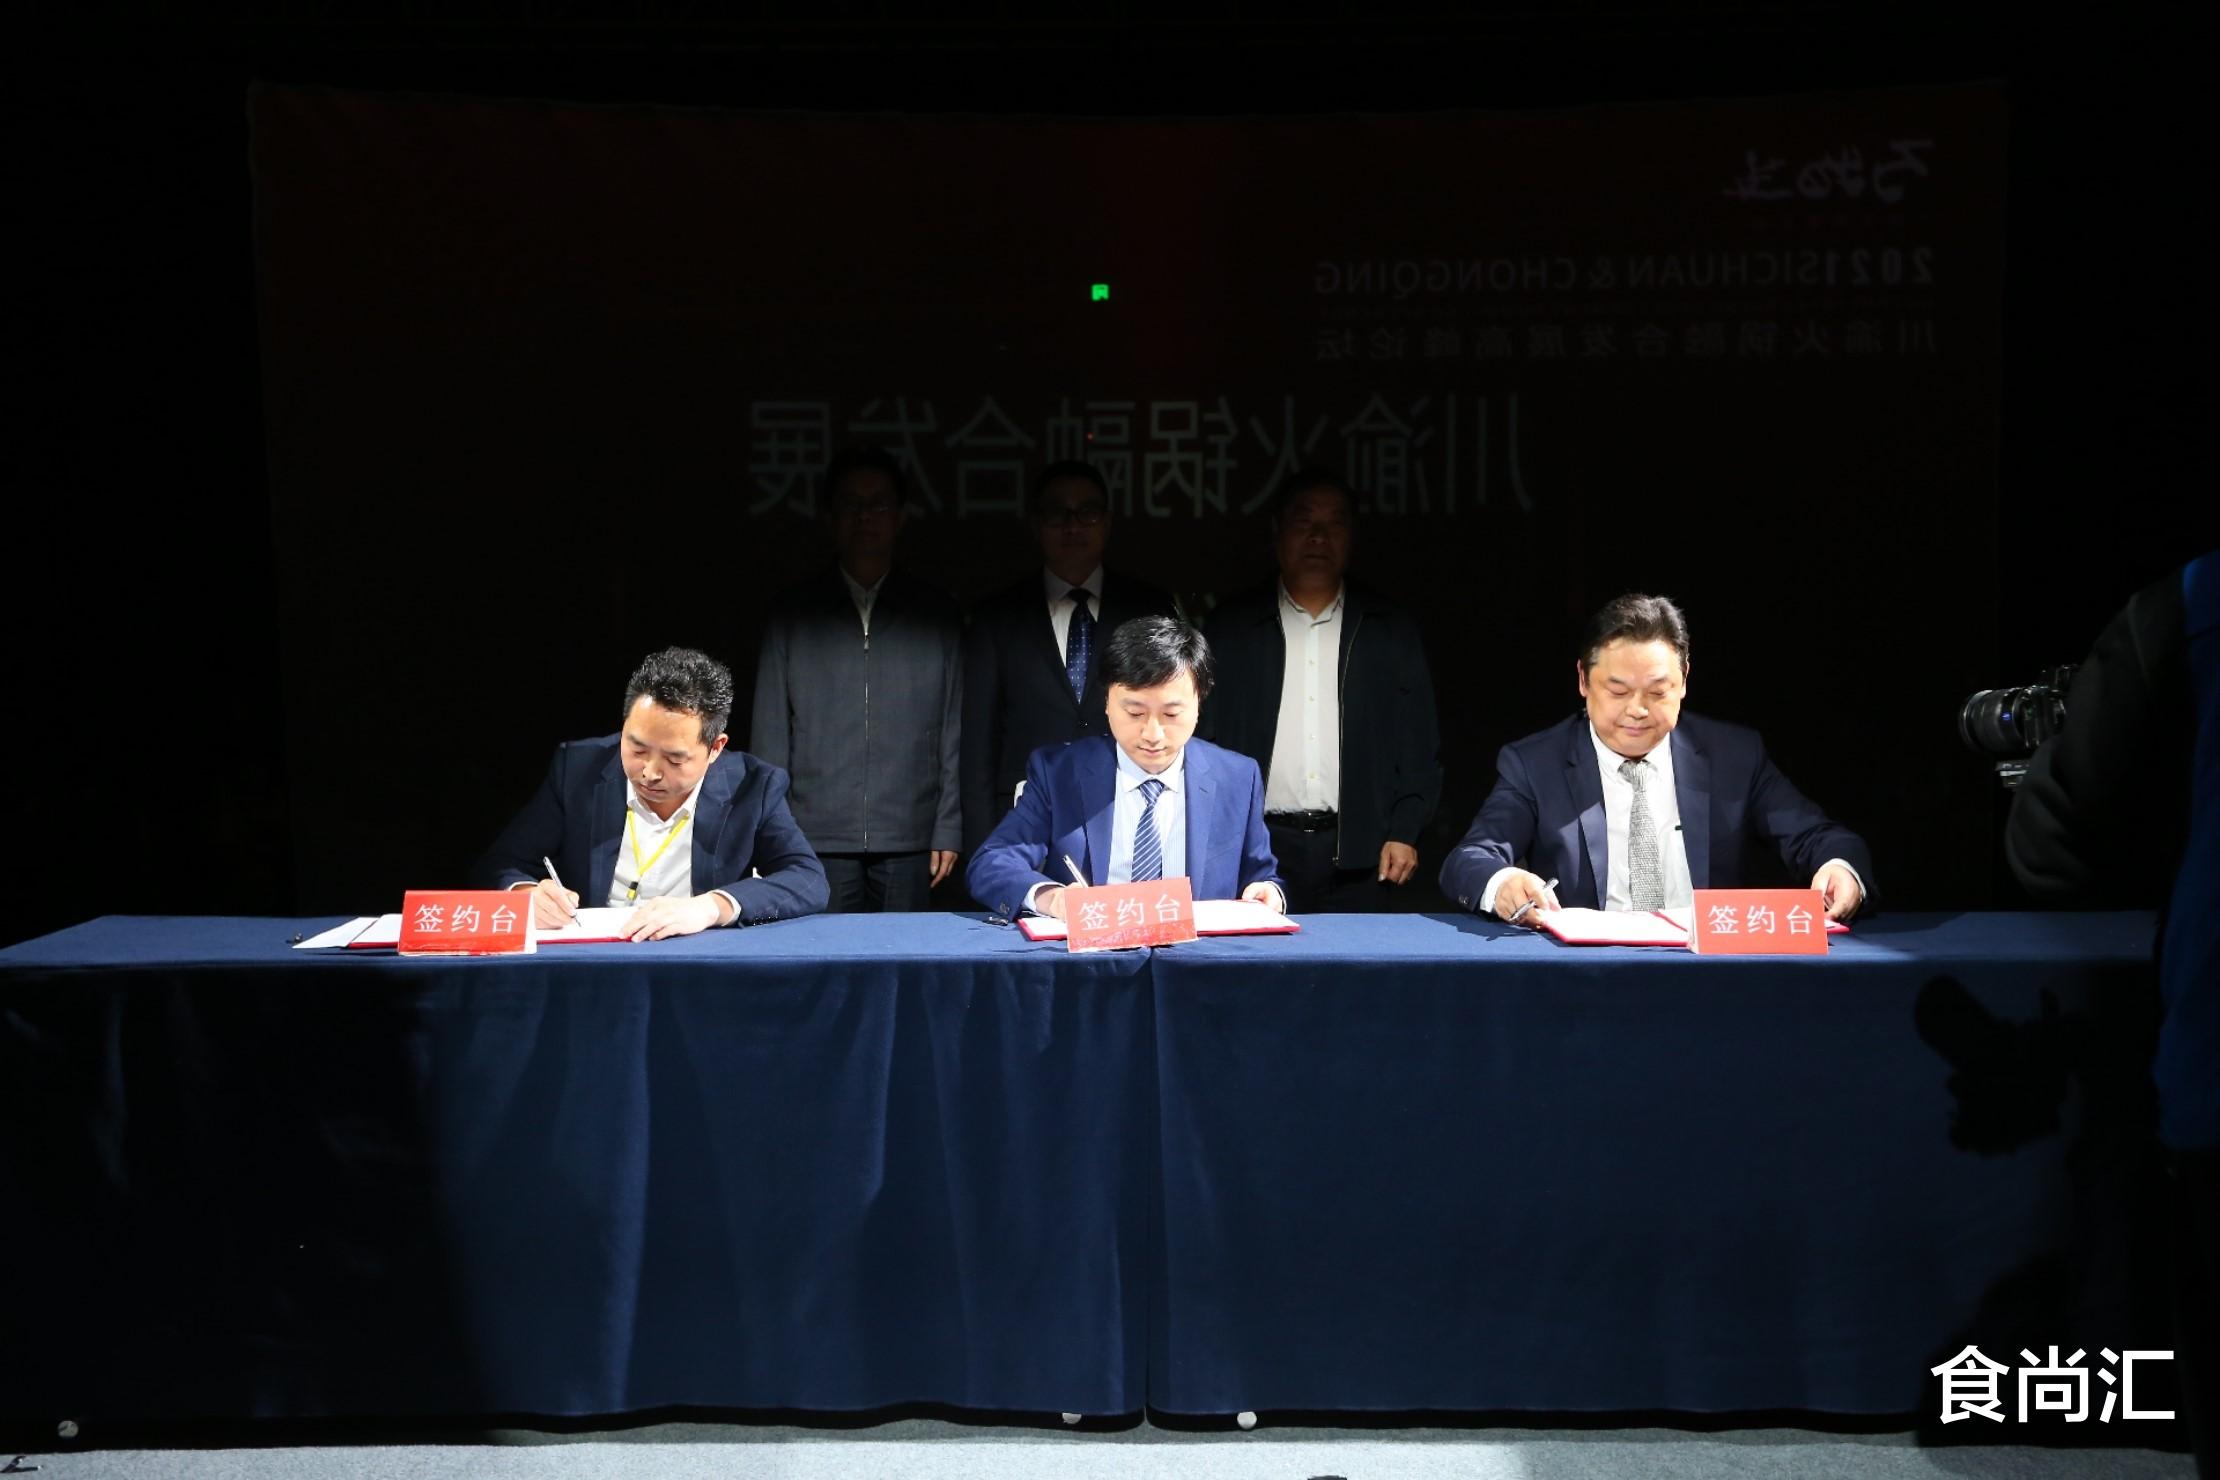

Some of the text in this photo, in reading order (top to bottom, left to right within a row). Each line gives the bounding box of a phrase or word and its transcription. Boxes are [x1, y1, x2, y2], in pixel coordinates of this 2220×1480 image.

[413, 903, 518, 934] 签约台
[1078, 893, 1181, 931] 签约台
[1708, 904, 1814, 935] 签约台
